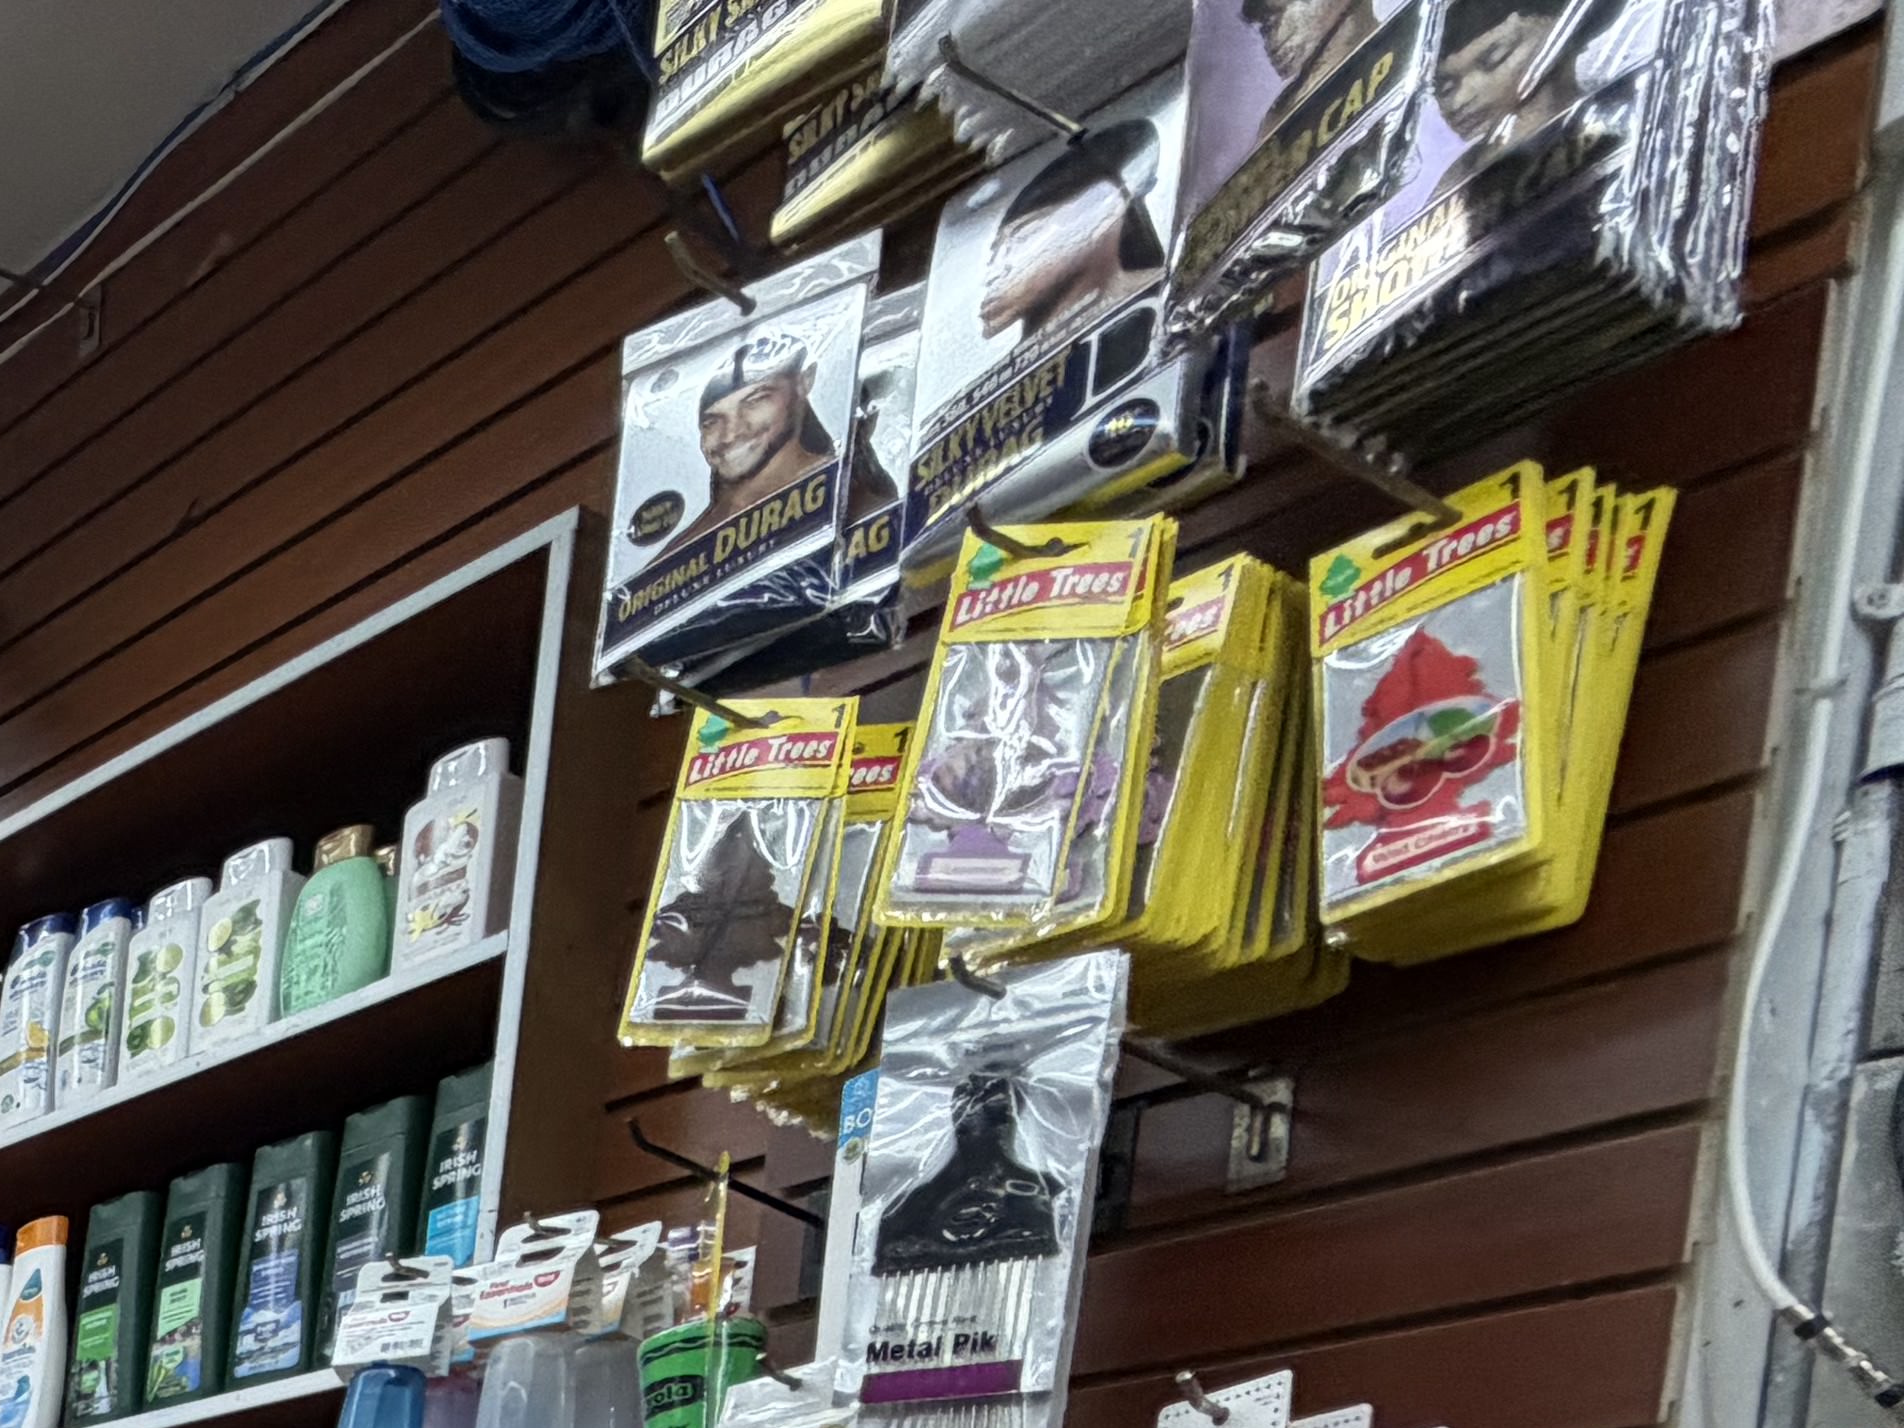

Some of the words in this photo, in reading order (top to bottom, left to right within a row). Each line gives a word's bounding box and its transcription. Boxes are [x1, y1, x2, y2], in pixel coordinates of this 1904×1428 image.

[1315, 50, 1395, 149] CAP
[617, 553, 711, 622] ORIGINAL
[713, 473, 828, 563] DURAG
[1323, 563, 1412, 639] Little
[1423, 509, 1514, 571] Trees
[955, 580, 1039, 625] Little
[1049, 566, 1125, 598] Trees
[689, 744, 758, 780] Little
[767, 736, 834, 762] Trees
[439, 1148, 478, 1174] IRISH
[432, 1163, 482, 1191] SPRING
[346, 1183, 383, 1206] IRISH
[261, 1205, 298, 1228] IRISH
[339, 1197, 387, 1223] SPRING
[254, 1220, 303, 1243] SPRING
[170, 1237, 201, 1259] IRISH
[164, 1250, 205, 1273] SPRING
[82, 1277, 120, 1298] SPRING
[88, 1264, 118, 1286] IRISH
[866, 1337, 942, 1364] Metal
[952, 1328, 1000, 1359] Pik
